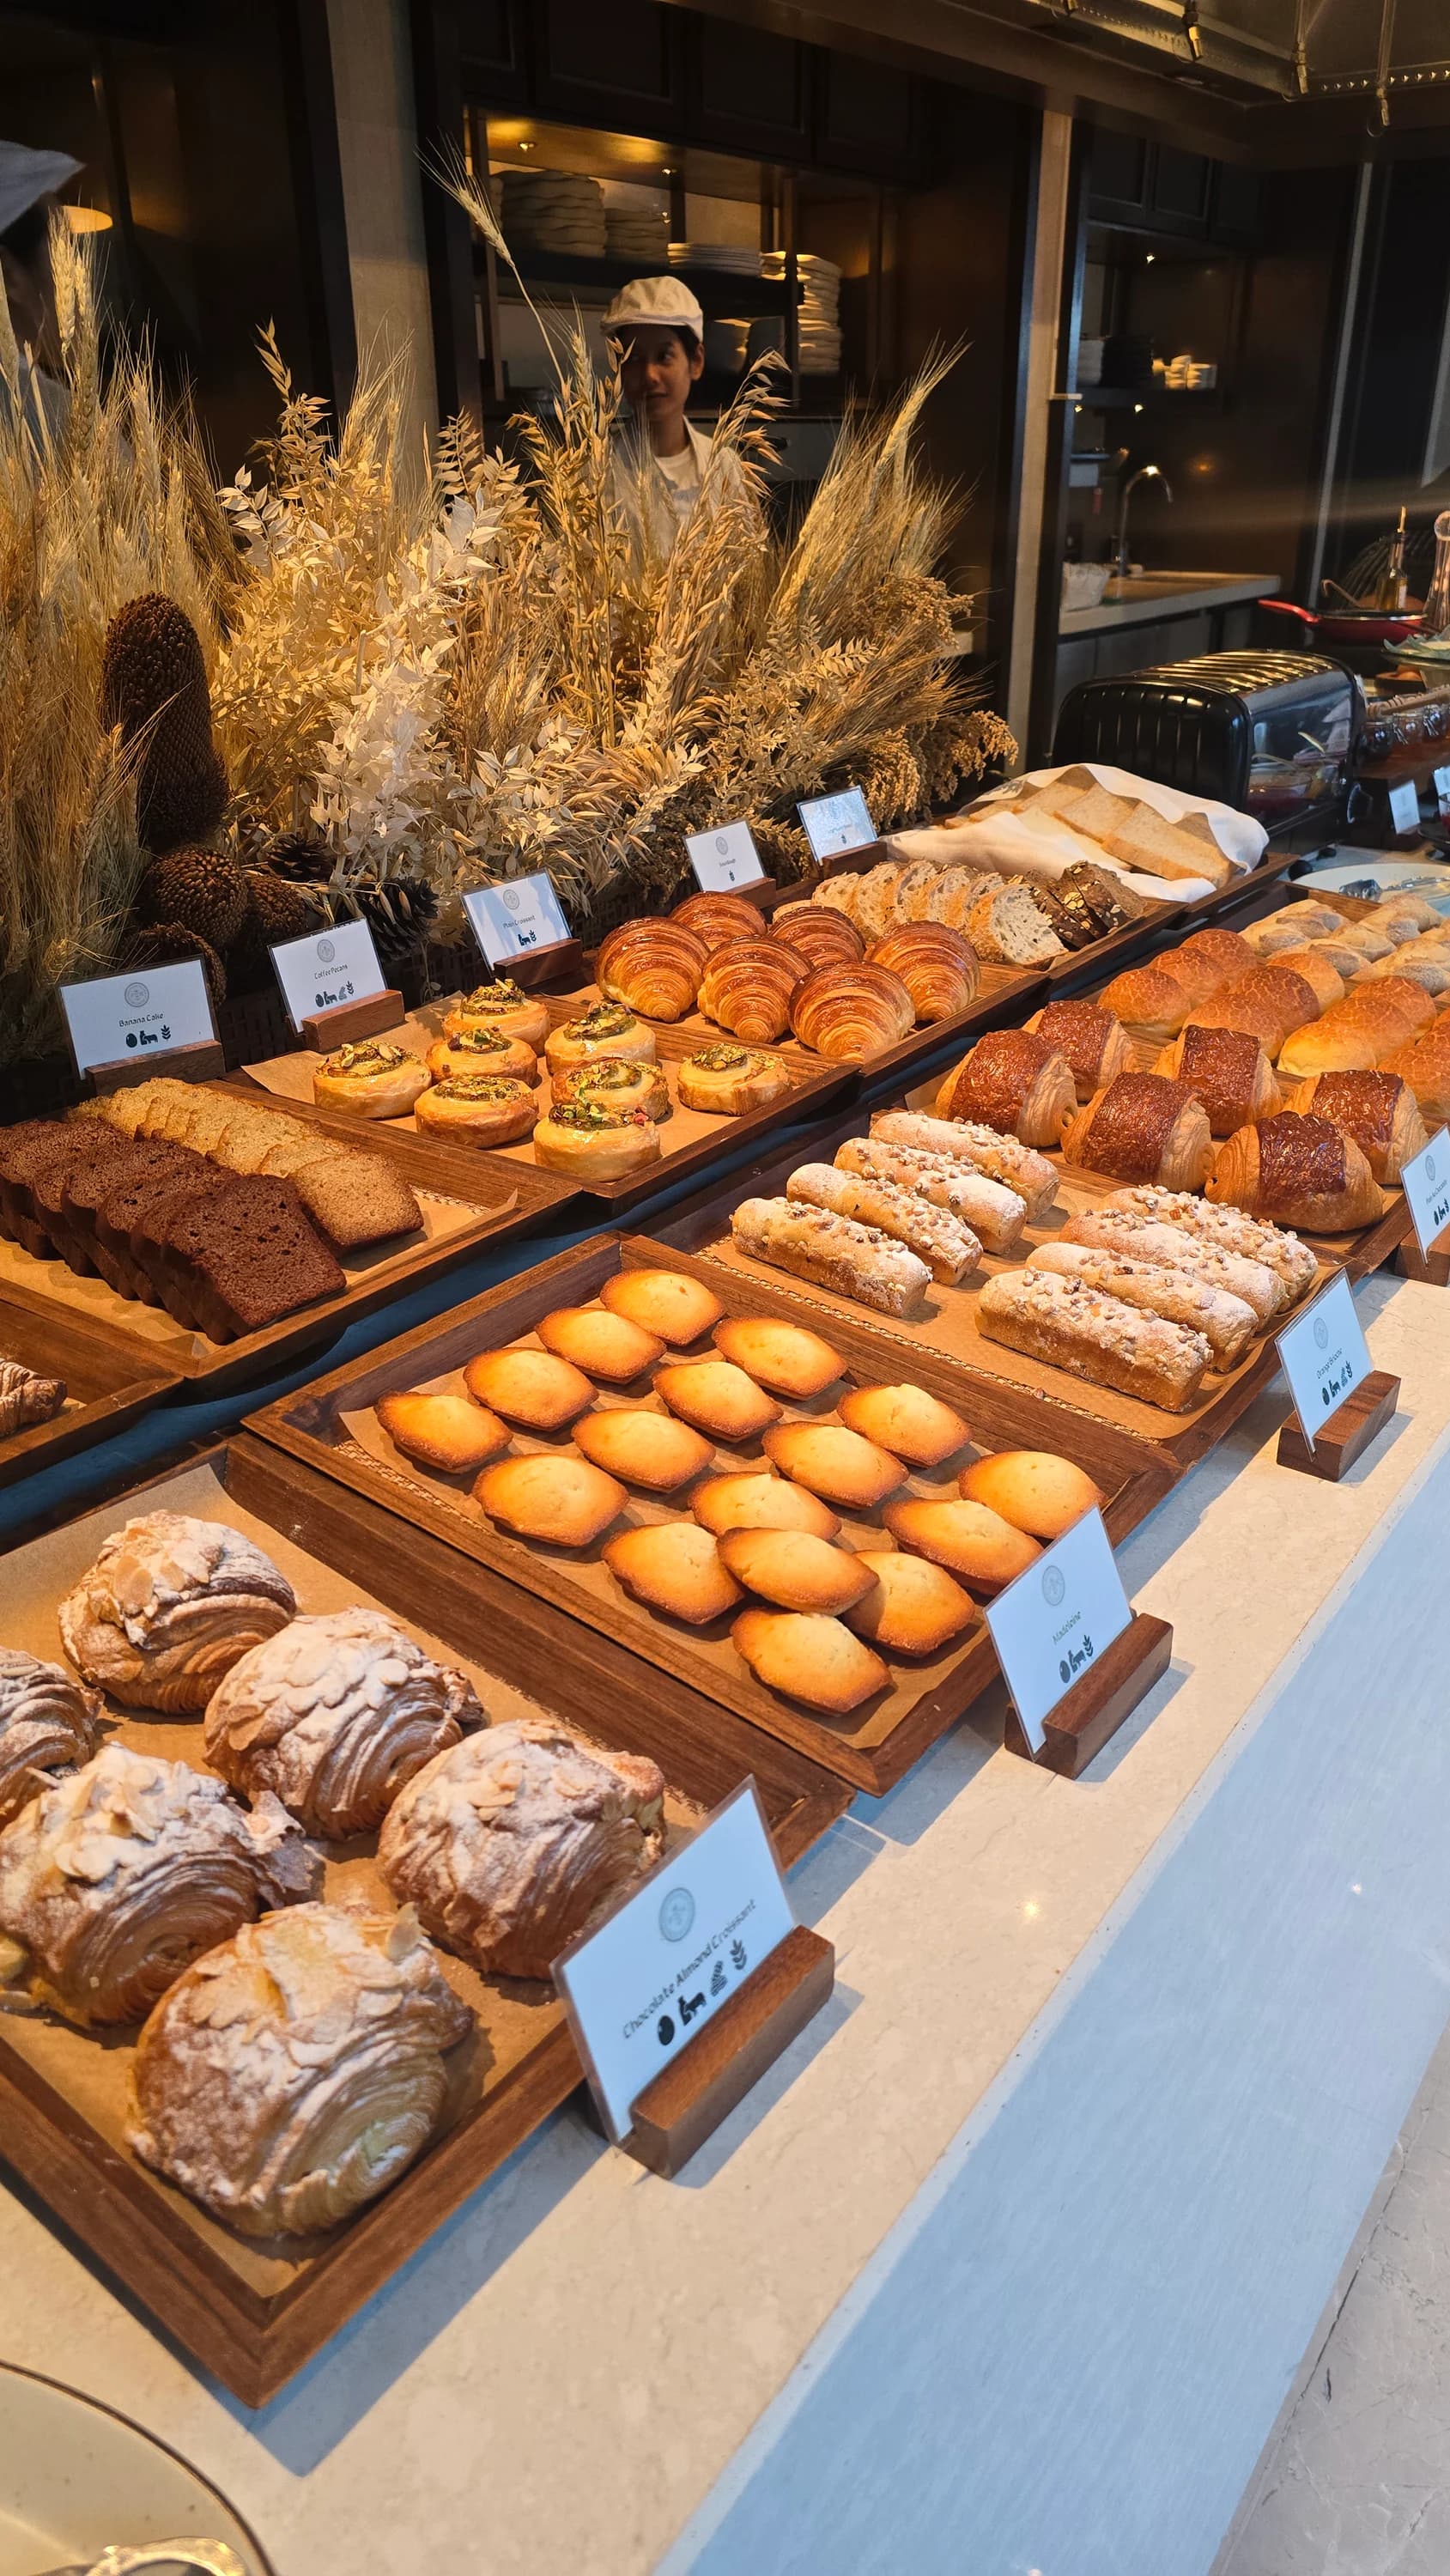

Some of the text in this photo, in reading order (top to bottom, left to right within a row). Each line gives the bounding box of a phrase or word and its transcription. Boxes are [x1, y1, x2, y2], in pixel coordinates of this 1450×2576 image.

[314, 963, 349, 980] Coffee Pecans
[118, 1012, 164, 1028] Banana Cake
[622, 1983, 676, 2039] Chocolate
[675, 1942, 713, 1987] Almond
[711, 1899, 756, 1950] Croissant
